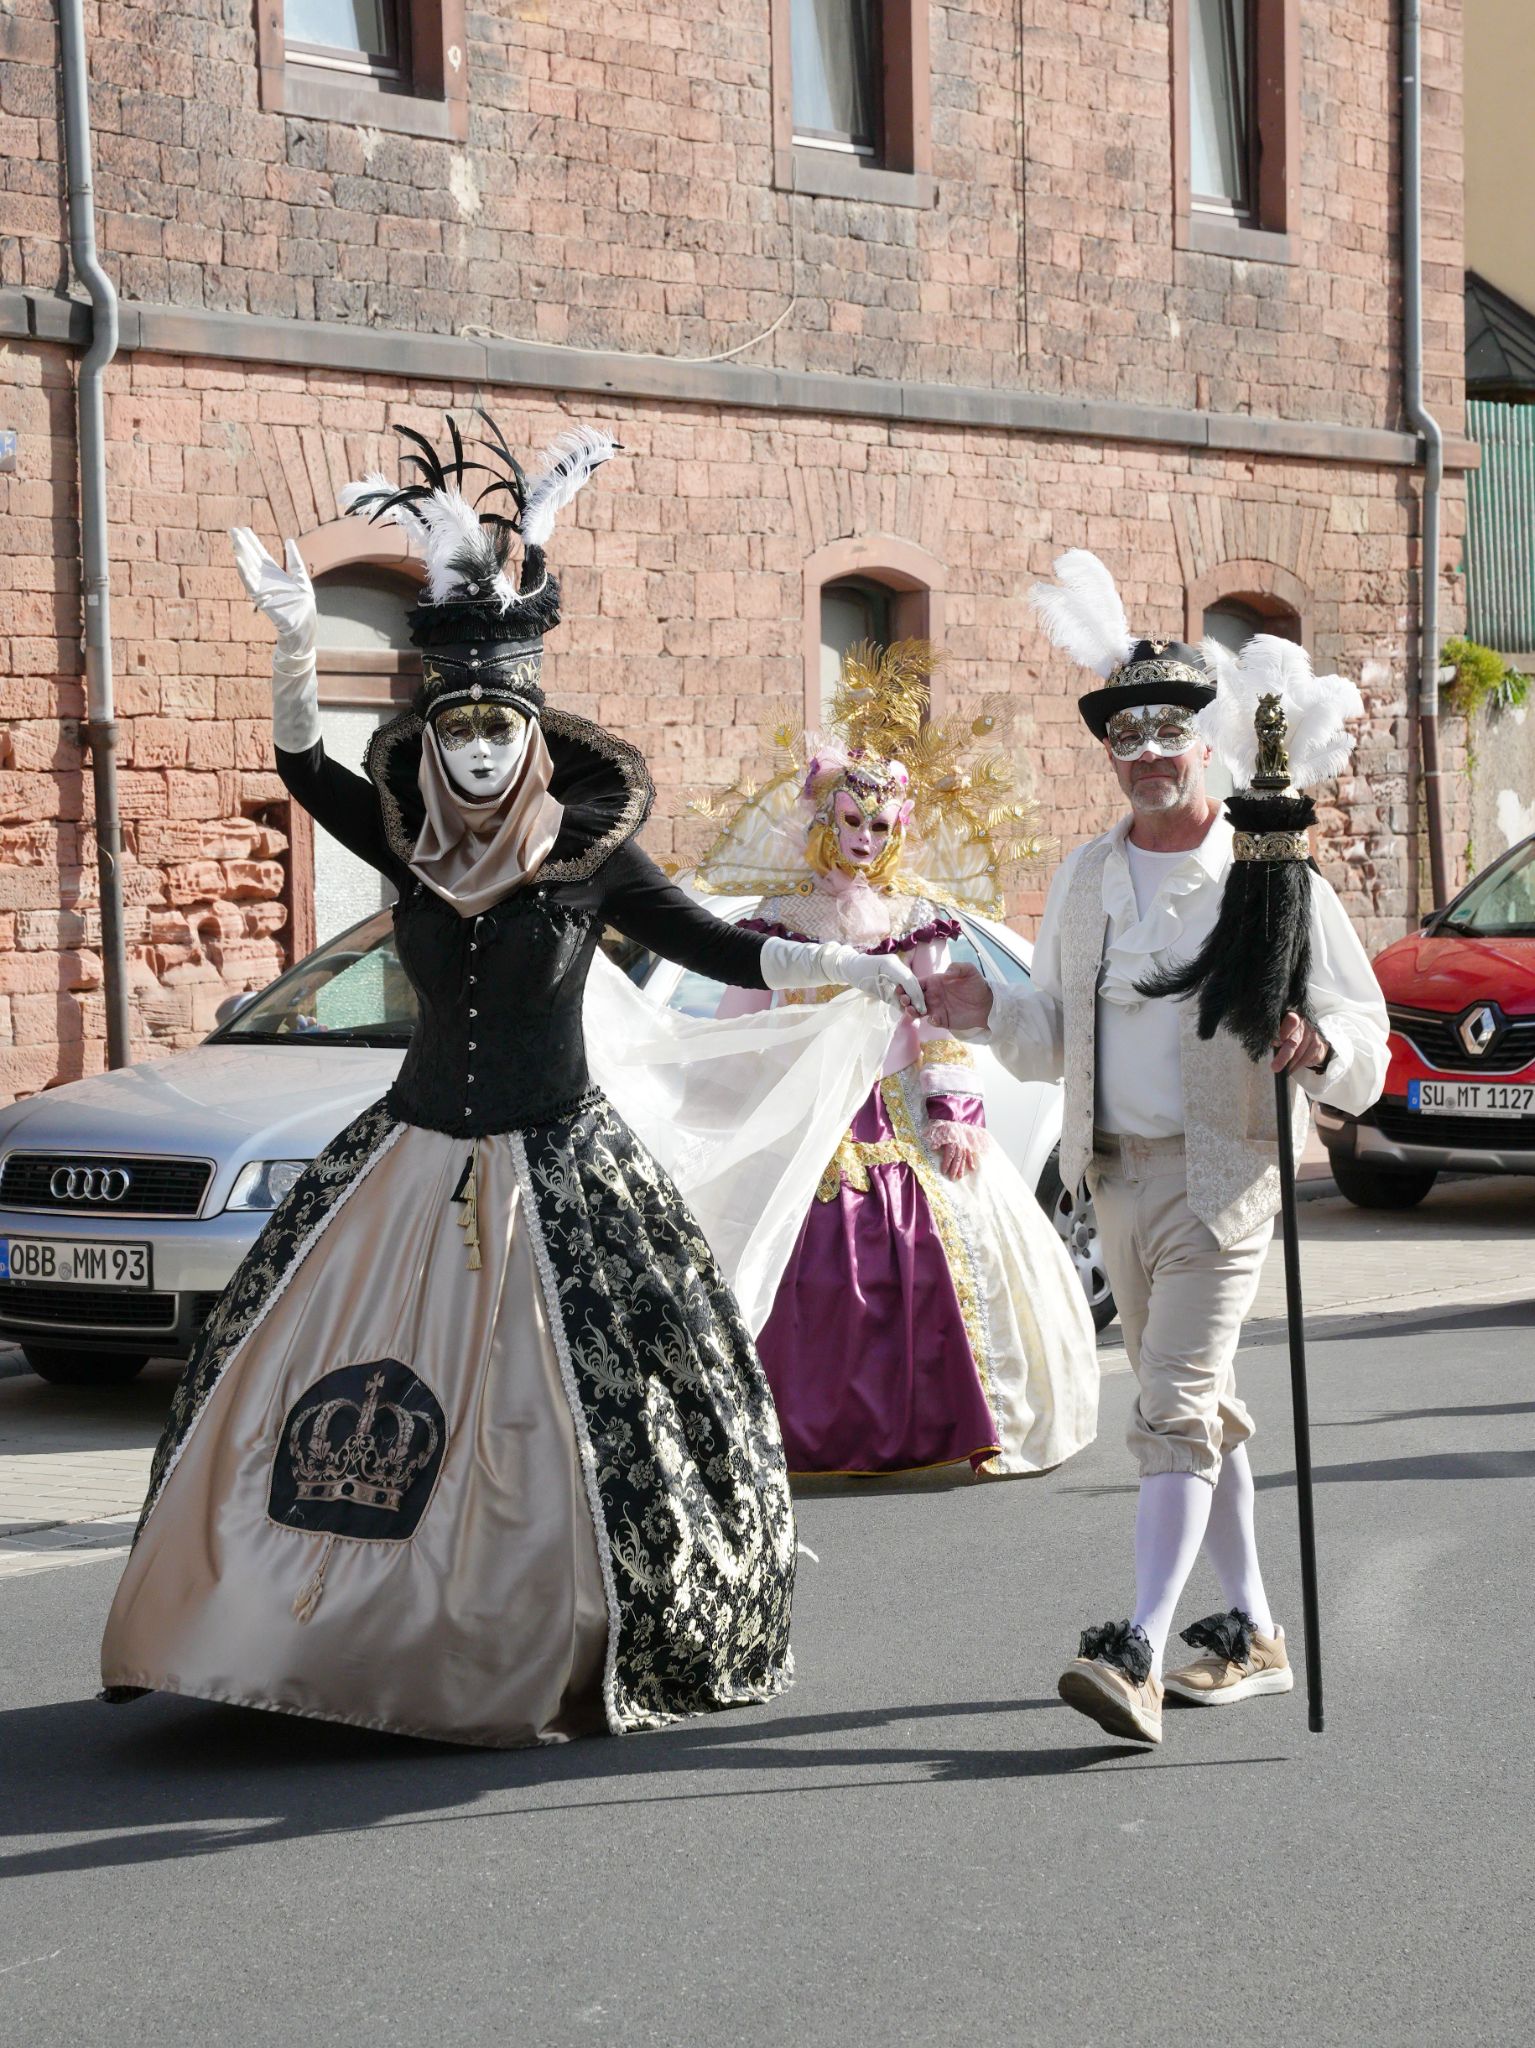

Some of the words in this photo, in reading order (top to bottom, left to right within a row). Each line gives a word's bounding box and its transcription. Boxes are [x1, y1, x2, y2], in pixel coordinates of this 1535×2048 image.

[1422, 1085, 1444, 1106] SU
[1457, 1086, 1481, 1108] MT
[1487, 1088, 1534, 1109] 1127
[10, 1244, 56, 1277] OBB
[73, 1247, 107, 1279] MM
[112, 1249, 145, 1280] 93
